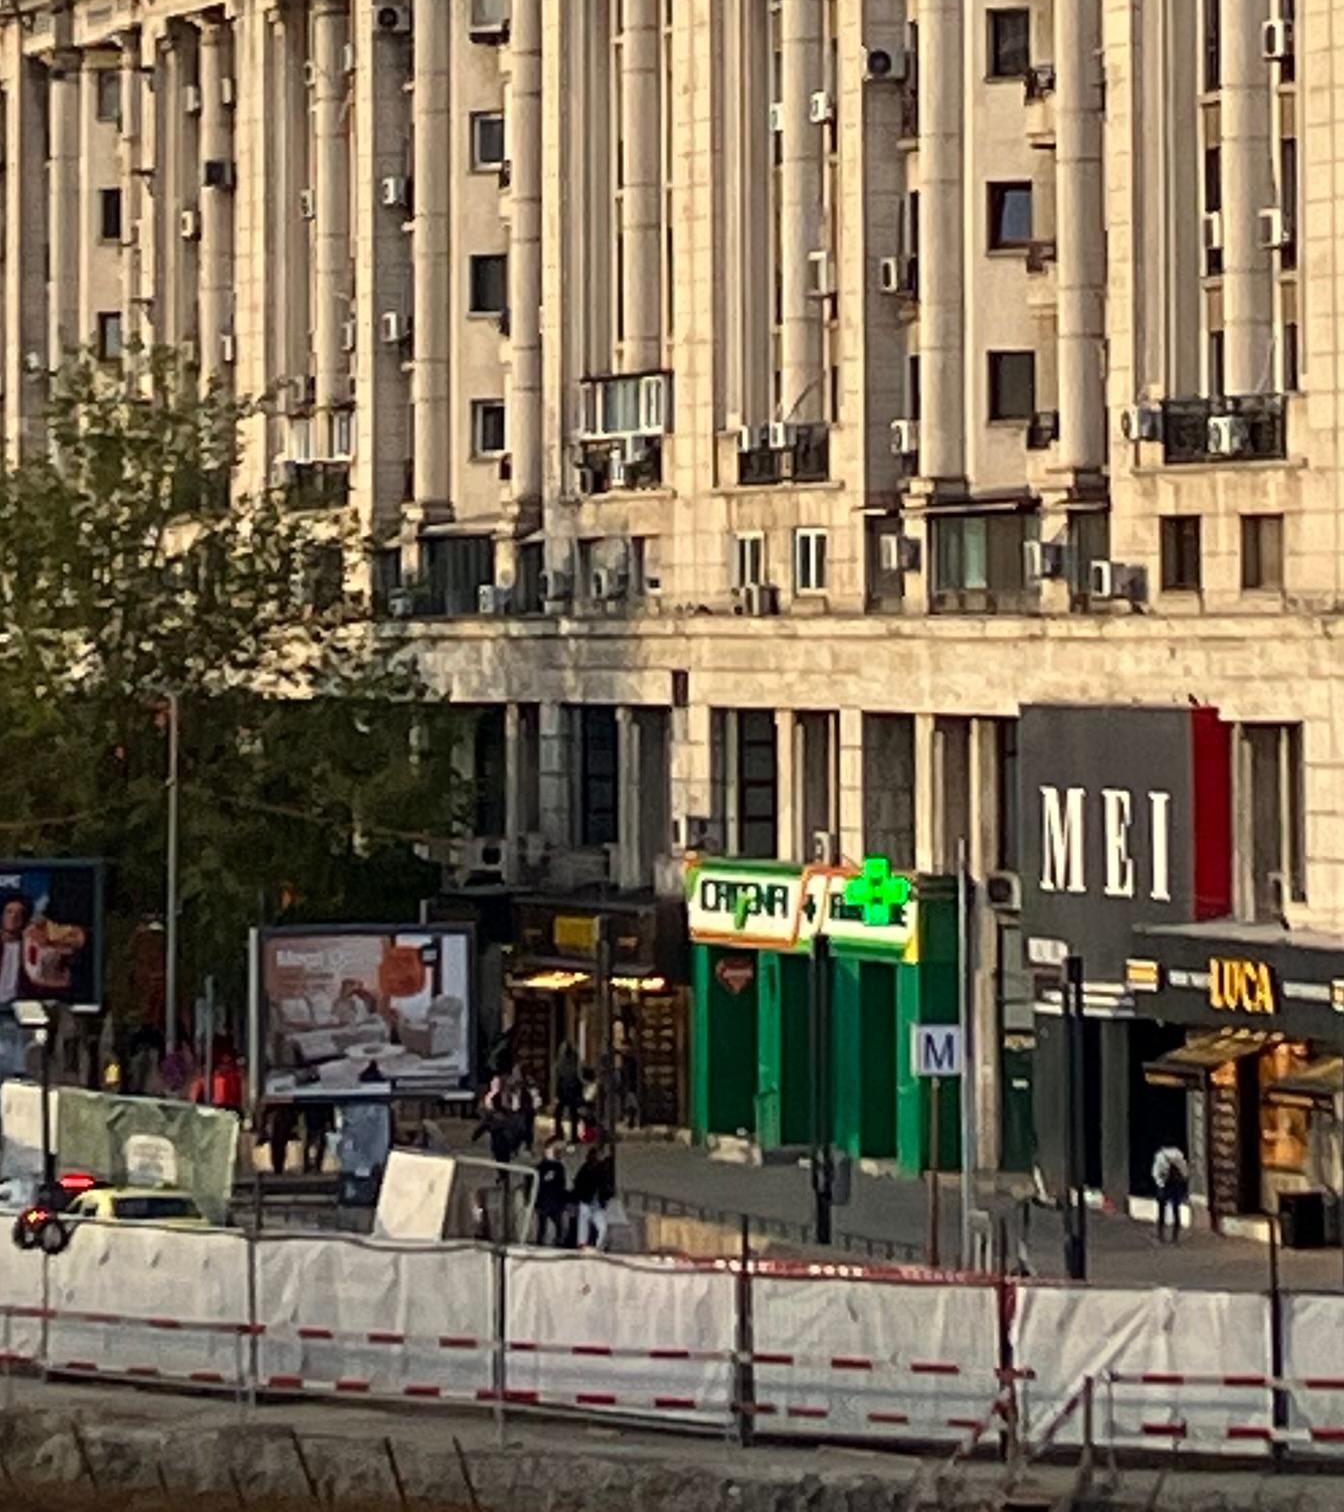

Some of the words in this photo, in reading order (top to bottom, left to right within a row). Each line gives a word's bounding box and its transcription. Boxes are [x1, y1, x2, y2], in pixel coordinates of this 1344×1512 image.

[1038, 784, 1171, 902] MEI
[1207, 956, 1277, 1015] LUCA
[923, 1032, 955, 1071] M
